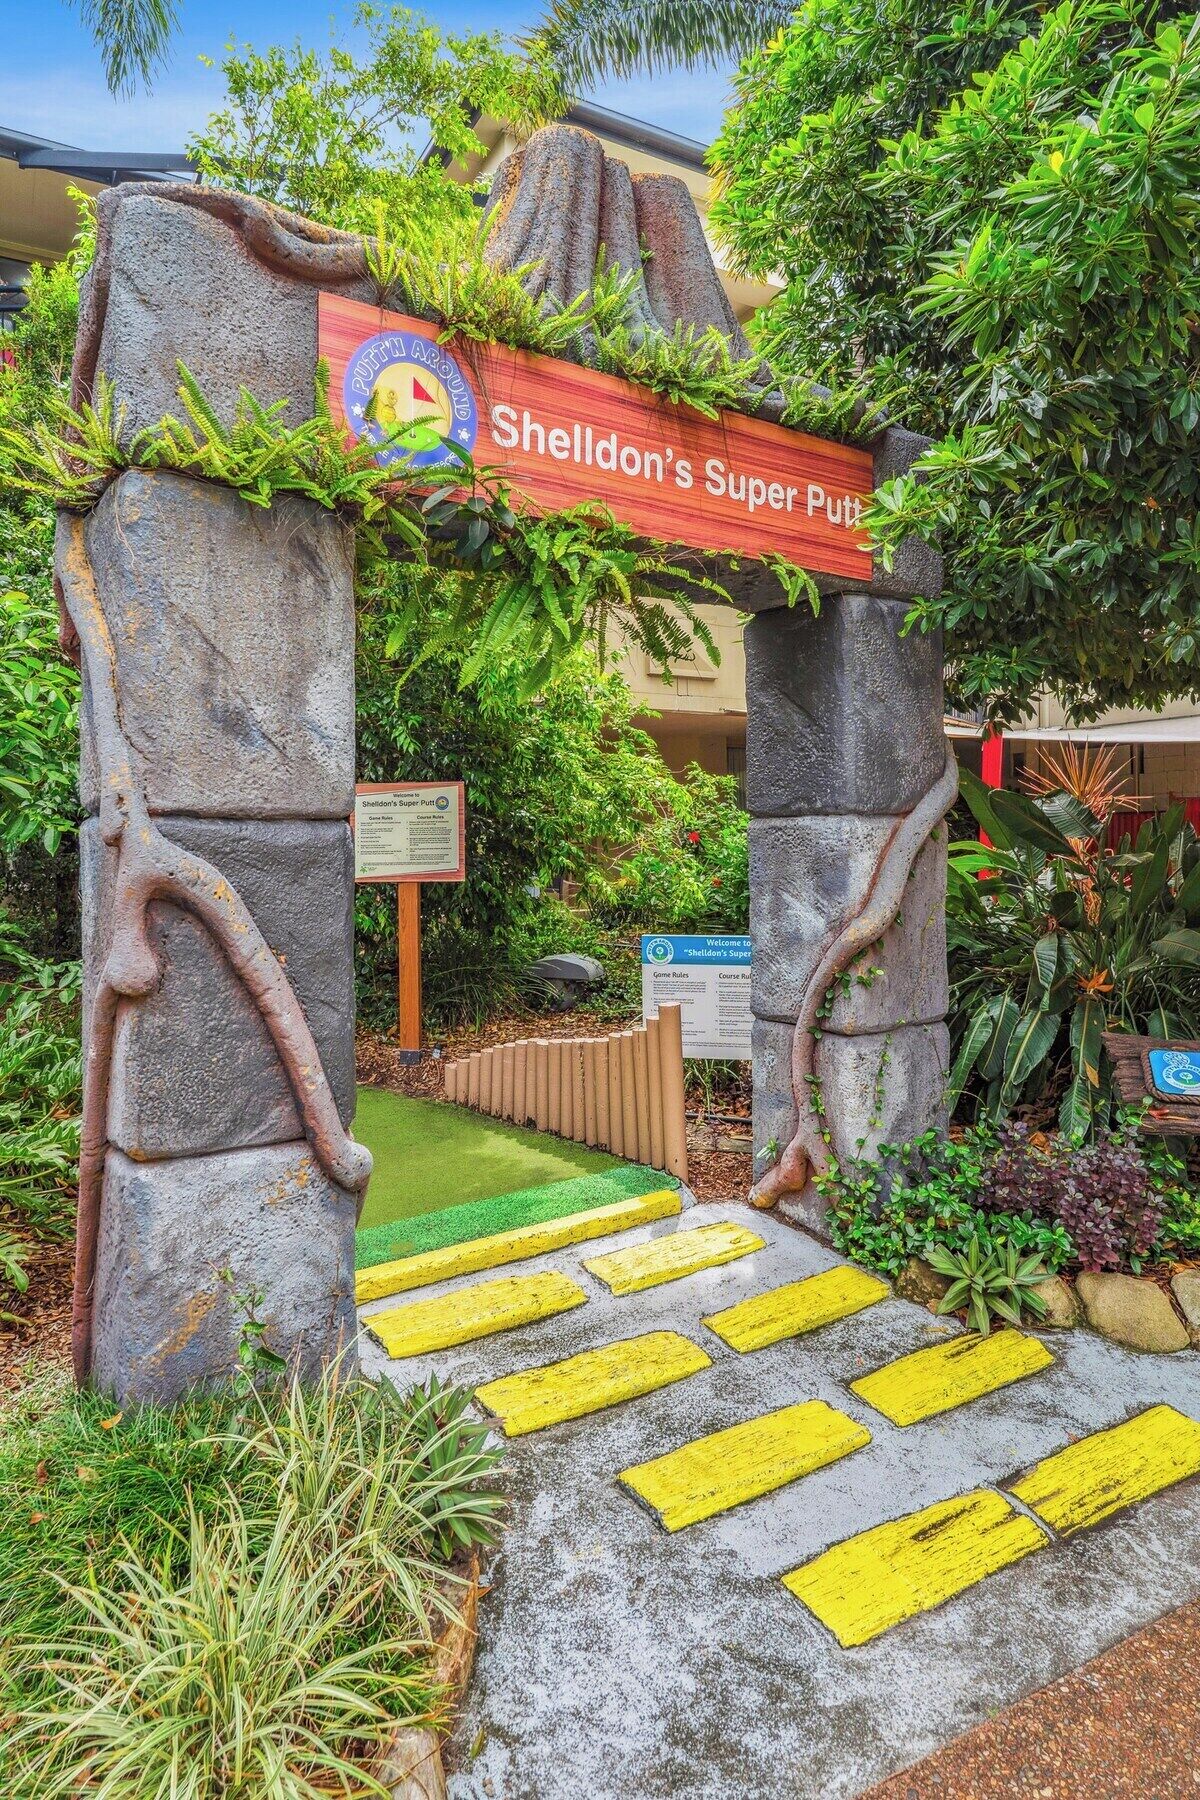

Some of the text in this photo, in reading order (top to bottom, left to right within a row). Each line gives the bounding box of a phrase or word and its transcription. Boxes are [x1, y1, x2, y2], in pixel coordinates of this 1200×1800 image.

[352, 338, 471, 420] PUTT'N AROUND
[491, 404, 864, 529] Shelldon's Super Putt
[362, 800, 398, 808] Shelldon's
[398, 799, 419, 808] Super
[706, 939, 742, 947] Welcome
[729, 949, 752, 959] Super
[653, 971, 671, 979] Game
[718, 972, 740, 980] Course
